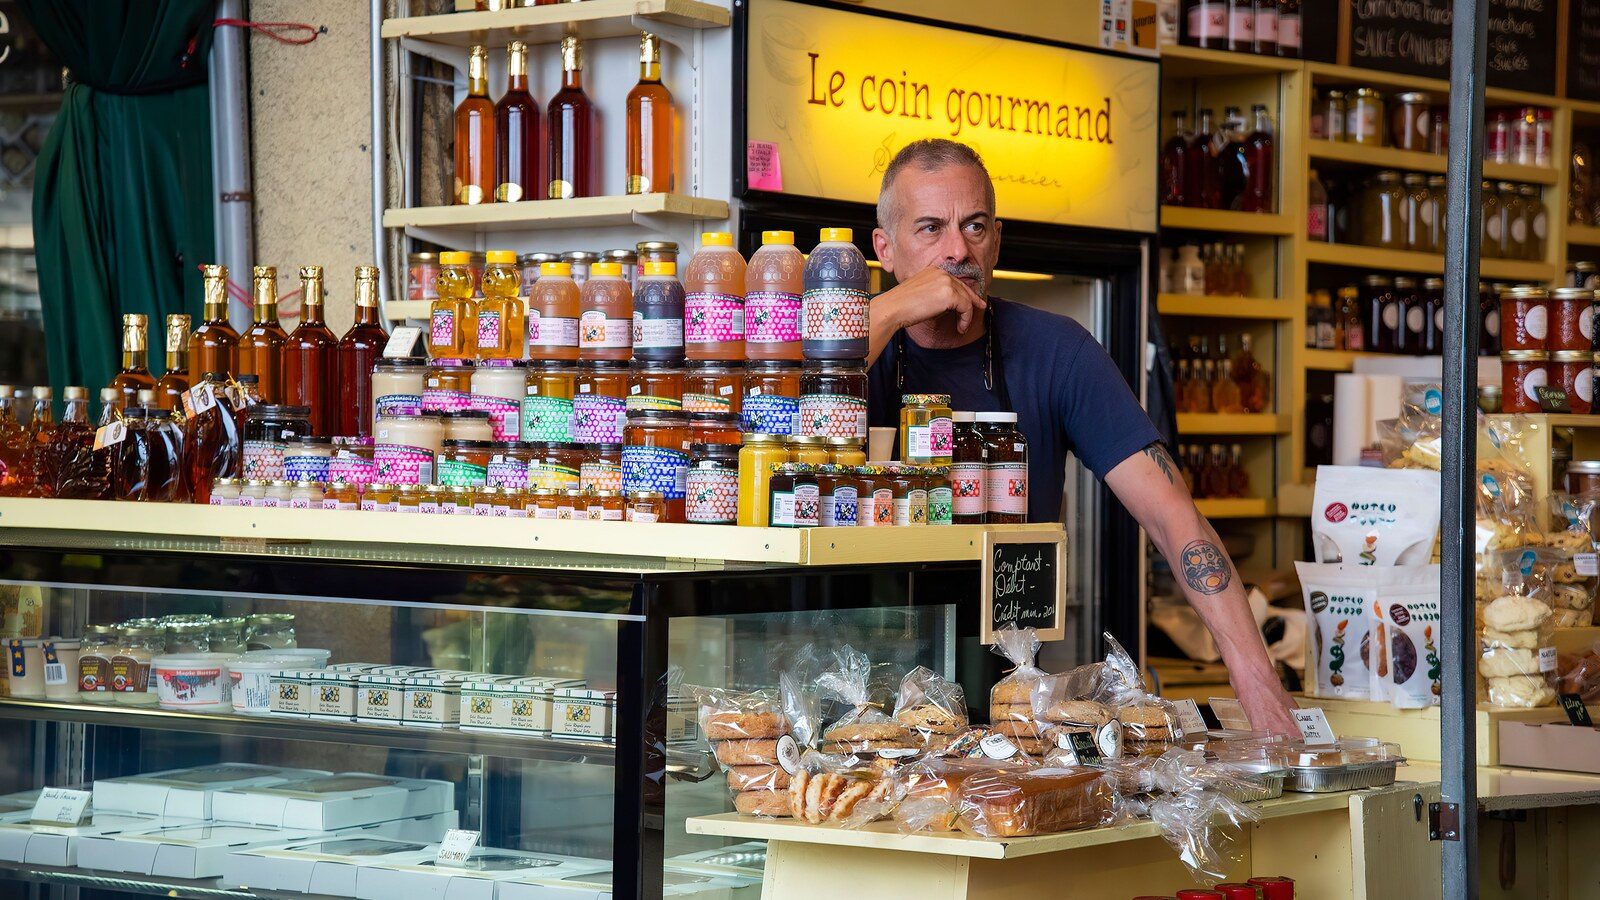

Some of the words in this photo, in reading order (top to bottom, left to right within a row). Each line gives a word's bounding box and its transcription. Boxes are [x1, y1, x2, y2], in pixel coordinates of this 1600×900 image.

[807, 52, 845, 107] Le
[860, 70, 932, 120] coin
[946, 88, 1113, 144] gourmand
[994, 549, 1042, 581] Comptant
[995, 573, 1026, 598] Débit
[994, 600, 1021, 622] Crédit
